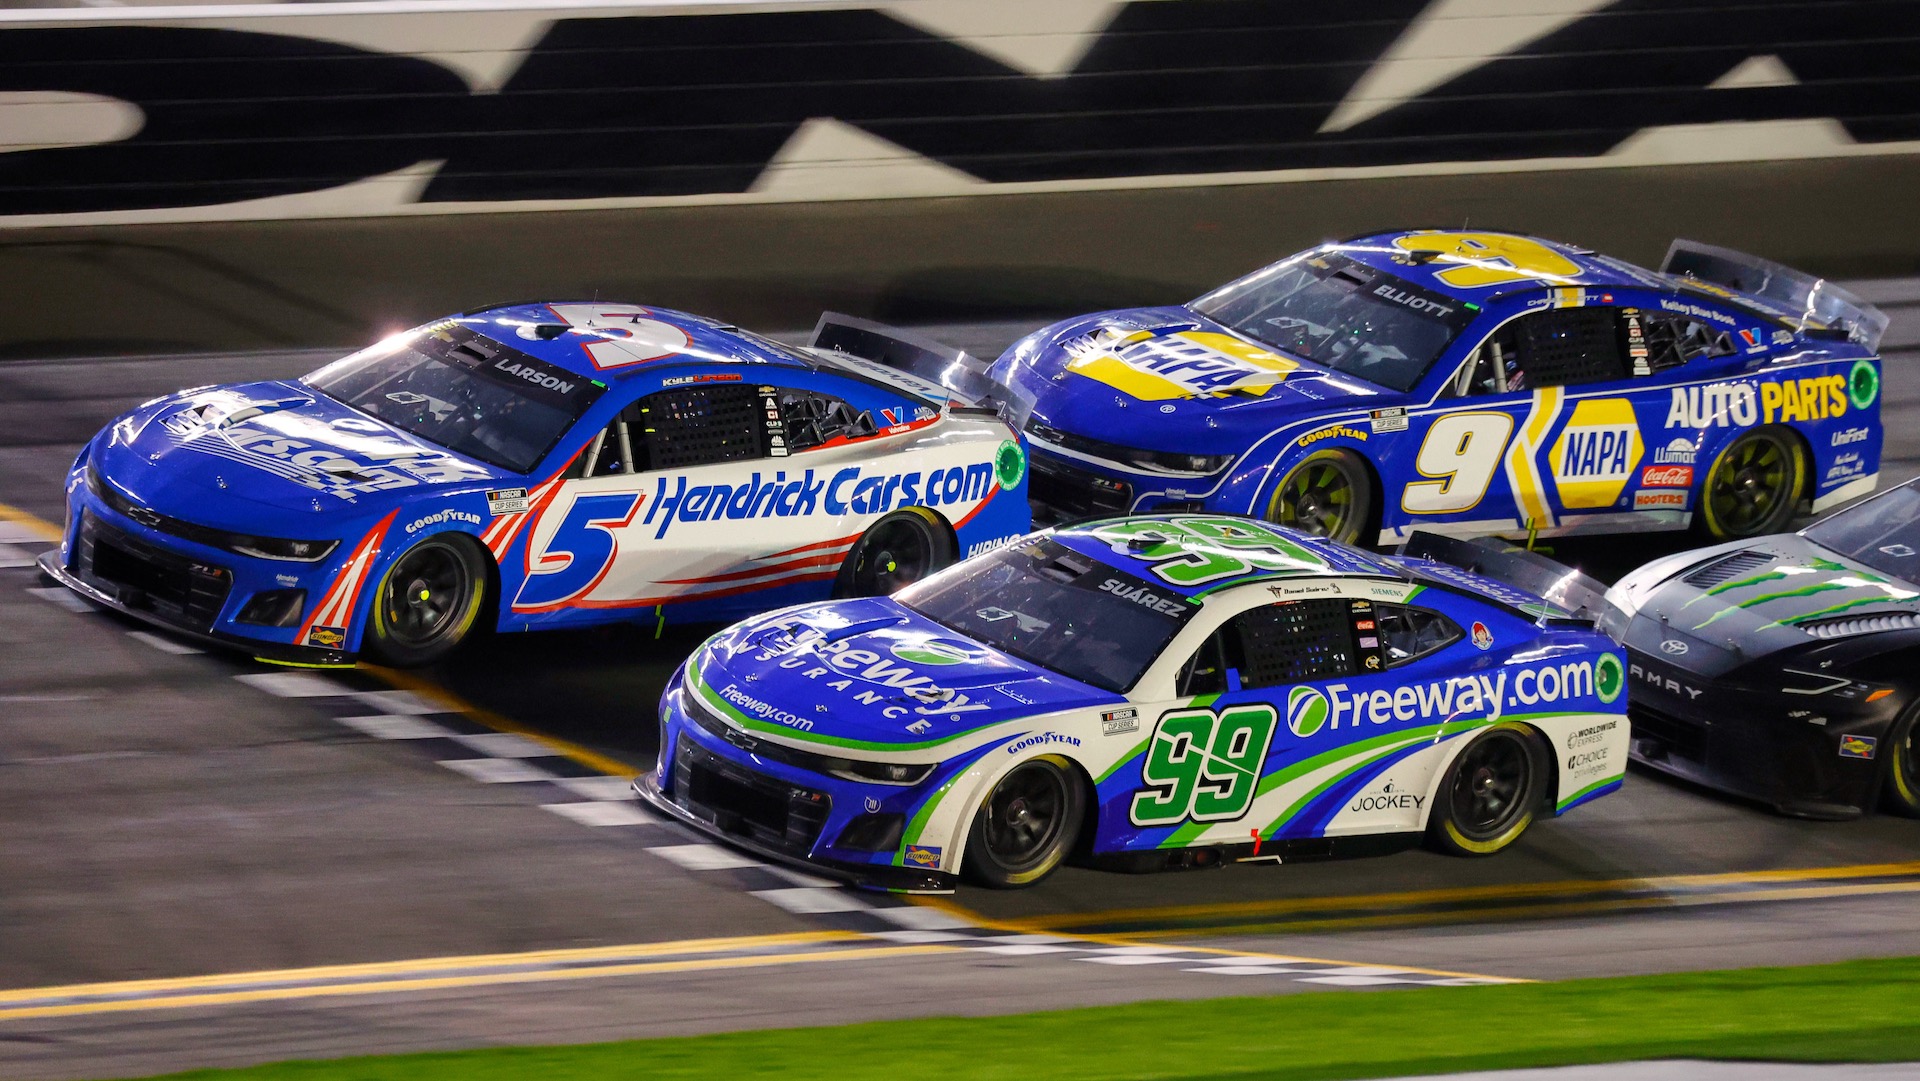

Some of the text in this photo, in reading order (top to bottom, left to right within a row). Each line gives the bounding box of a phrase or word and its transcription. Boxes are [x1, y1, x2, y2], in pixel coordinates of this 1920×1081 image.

[1392, 232, 1586, 289] 9
[1373, 285, 1453, 317] ELLIOTT
[547, 304, 693, 370] 5
[494, 358, 574, 394] LARSON
[1664, 383, 1757, 428] AUTO
[1760, 374, 1847, 424] PARTS
[1298, 425, 1368, 447] GOODYEAR
[1564, 431, 1627, 476] NAPA
[1400, 410, 1514, 514] 9
[1636, 494, 1683, 506] HOOTERS
[405, 508, 480, 533] GOODYEAR
[513, 490, 644, 612] 5
[1093, 518, 1332, 586] 99
[1098, 578, 1188, 618] SUÁREZ
[1371, 588, 1404, 597] SIEMENS
[311, 633, 343, 641] SUNOCO
[752, 616, 992, 716] Freeway
[1629, 664, 1703, 699] AMRY
[736, 640, 932, 735] NSURANCE
[1328, 660, 1593, 730] Freeway.com
[719, 683, 814, 731] Freeway.com
[1007, 731, 1081, 754] GOODYEAR
[1108, 720, 1134, 731] CUP SERIES
[1577, 733, 1604, 748] EXPRESS
[1578, 720, 1617, 738] WORLDWIDE
[1130, 704, 1277, 826] 99
[1576, 747, 1608, 767] CHOICE
[1352, 795, 1425, 812] JOCKEY
[907, 852, 940, 862] SUNOCO
